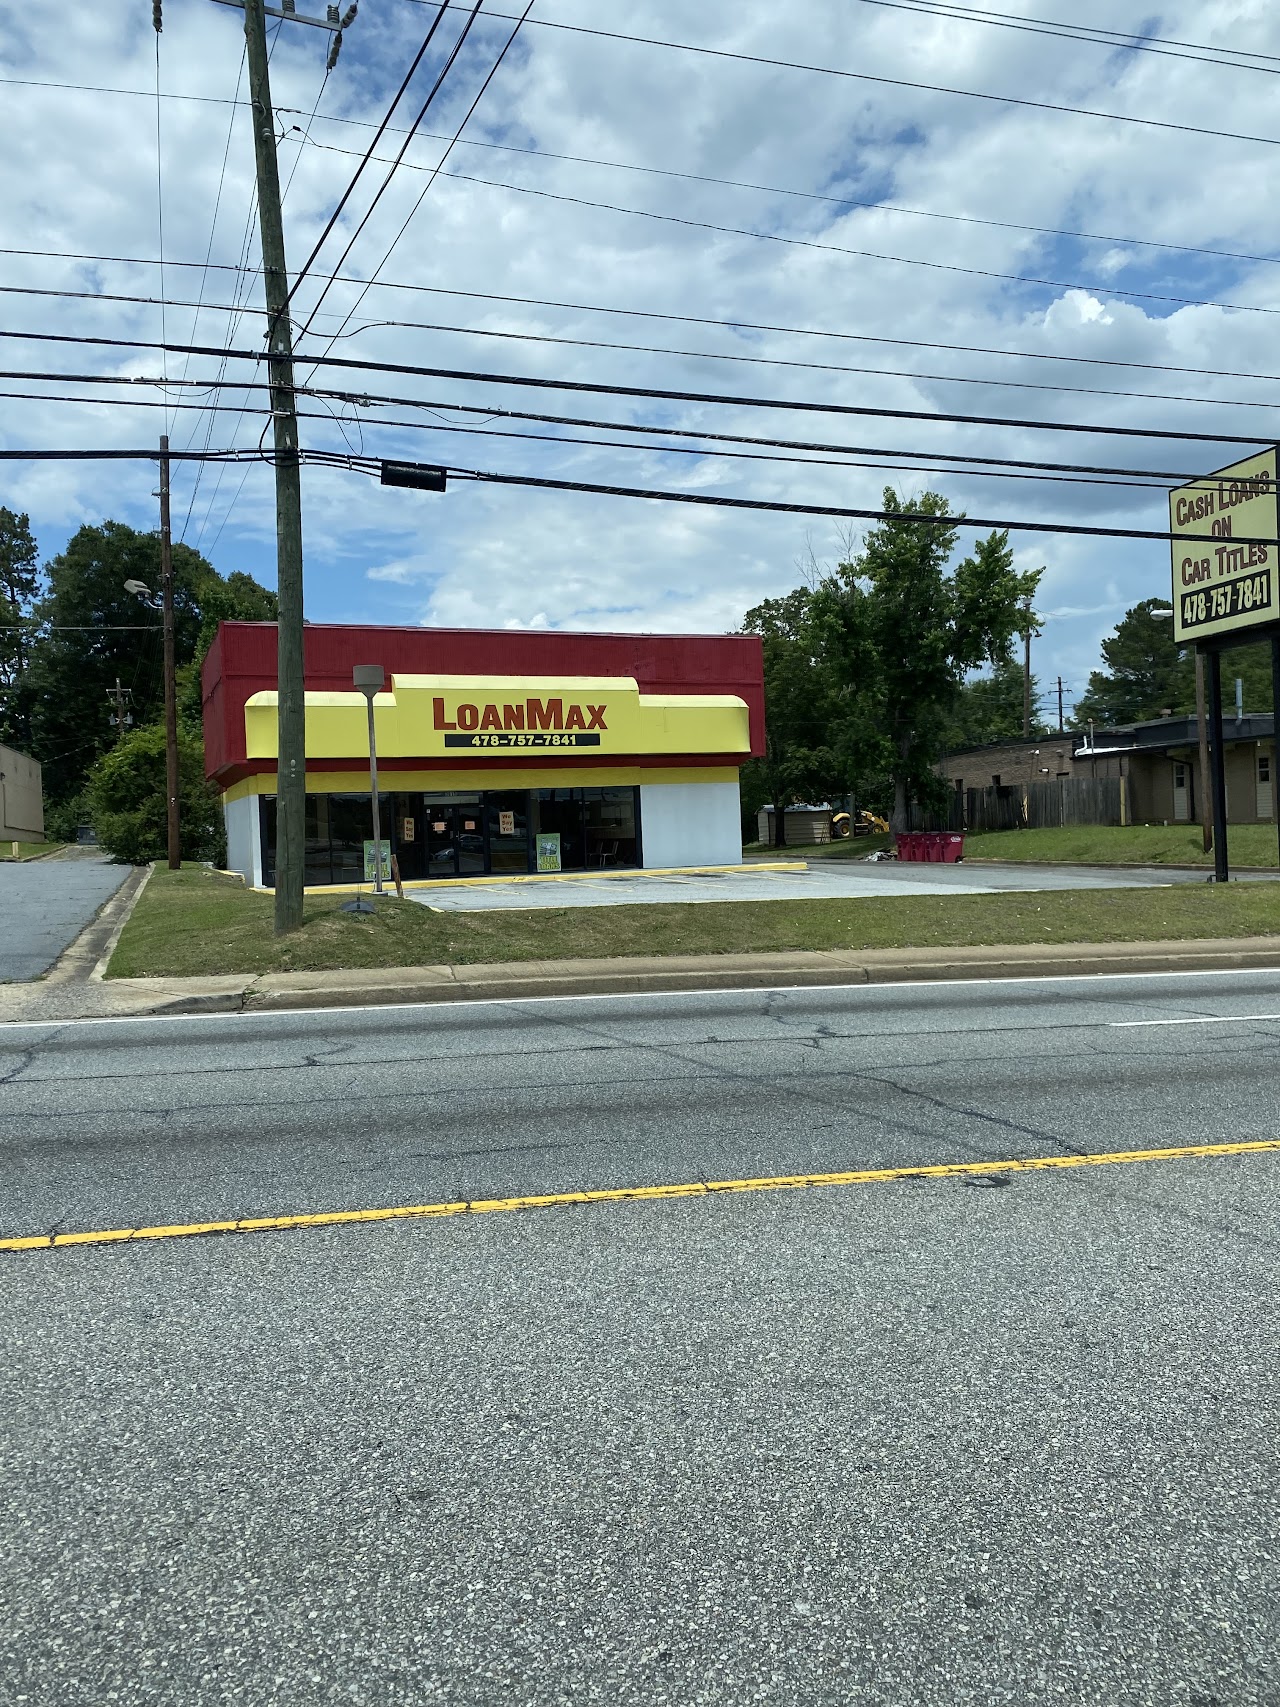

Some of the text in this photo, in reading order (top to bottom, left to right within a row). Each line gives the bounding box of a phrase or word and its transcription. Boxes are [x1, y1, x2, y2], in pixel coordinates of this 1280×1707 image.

[1176, 470, 1270, 526] CASH LOANS
[1211, 515, 1232, 538] ON
[1182, 544, 1268, 586] CAR TITLES
[1184, 574, 1268, 623] 478-757-7841
[471, 735, 577, 746] 478-757-7841
